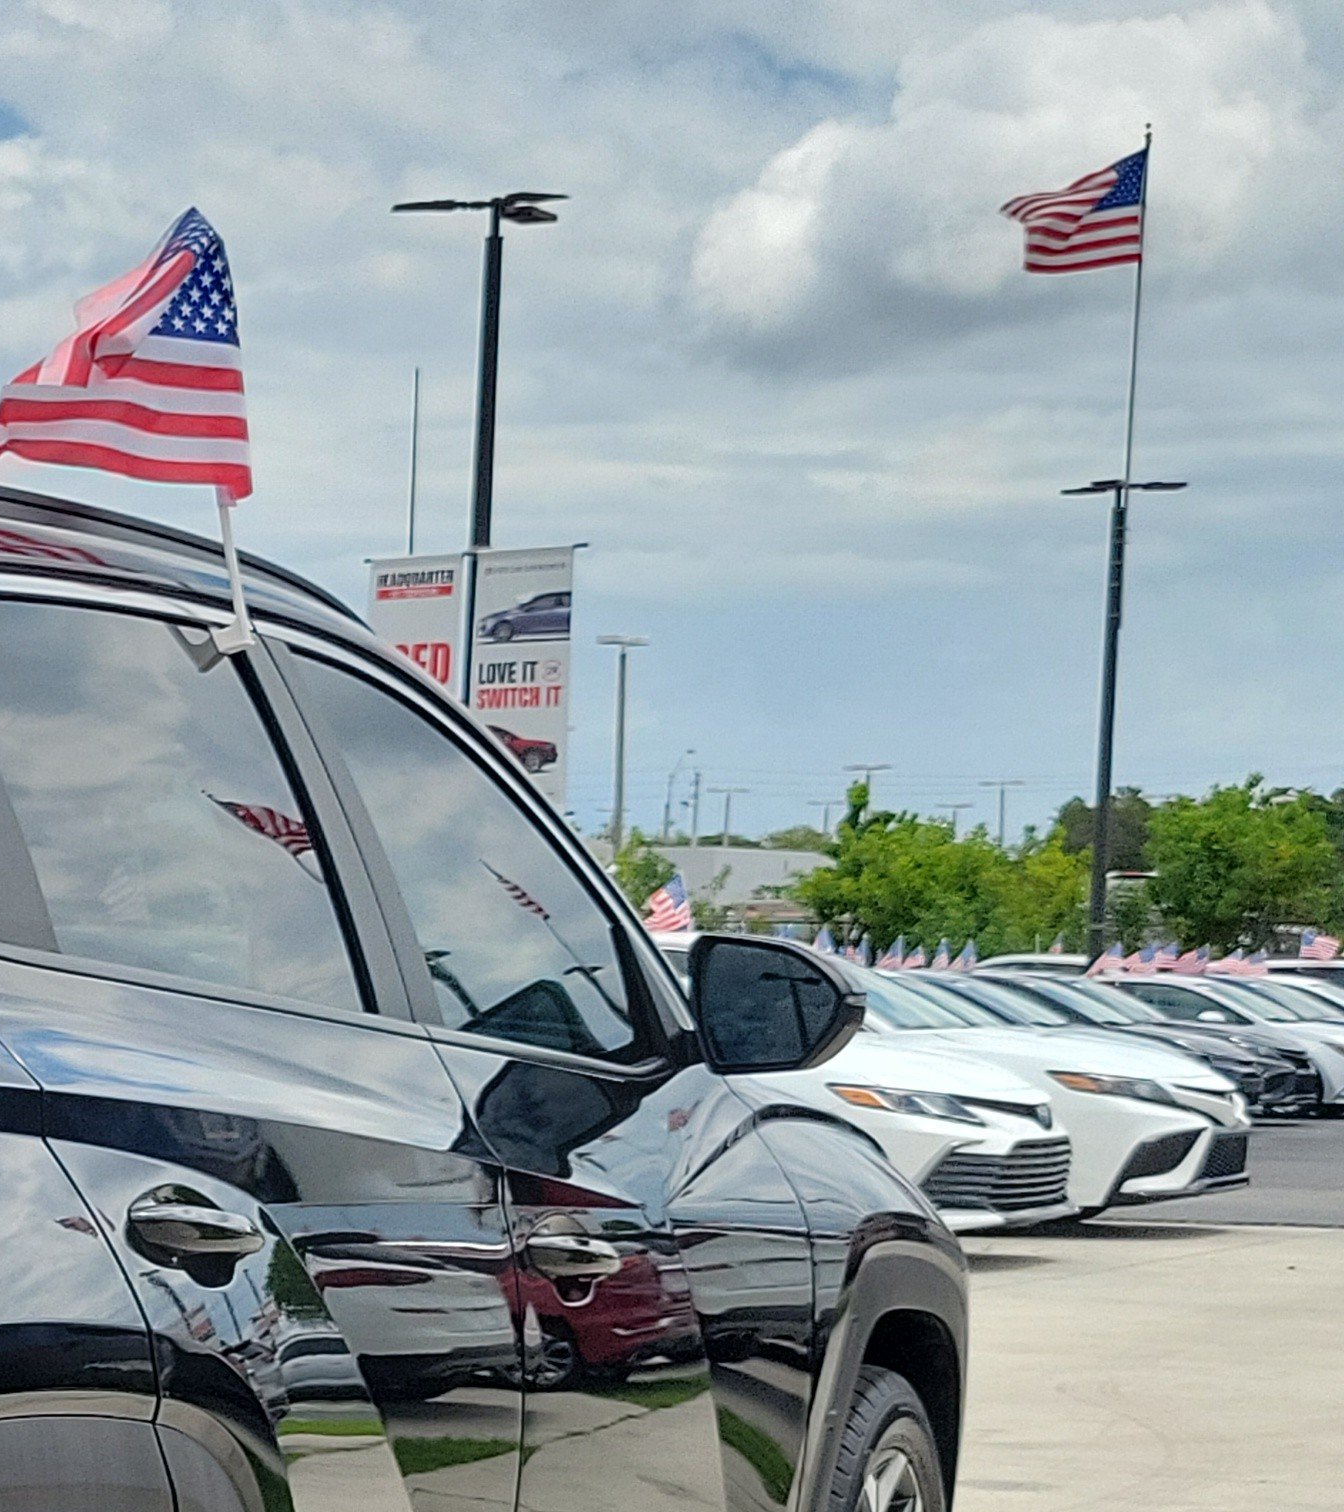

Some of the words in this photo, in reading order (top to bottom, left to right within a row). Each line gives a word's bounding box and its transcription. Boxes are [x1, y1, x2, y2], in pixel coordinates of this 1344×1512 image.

[478, 661, 517, 685] LOVE
[522, 661, 538, 682] IT
[477, 687, 540, 709] SWITCH
[546, 686, 562, 706] IT
